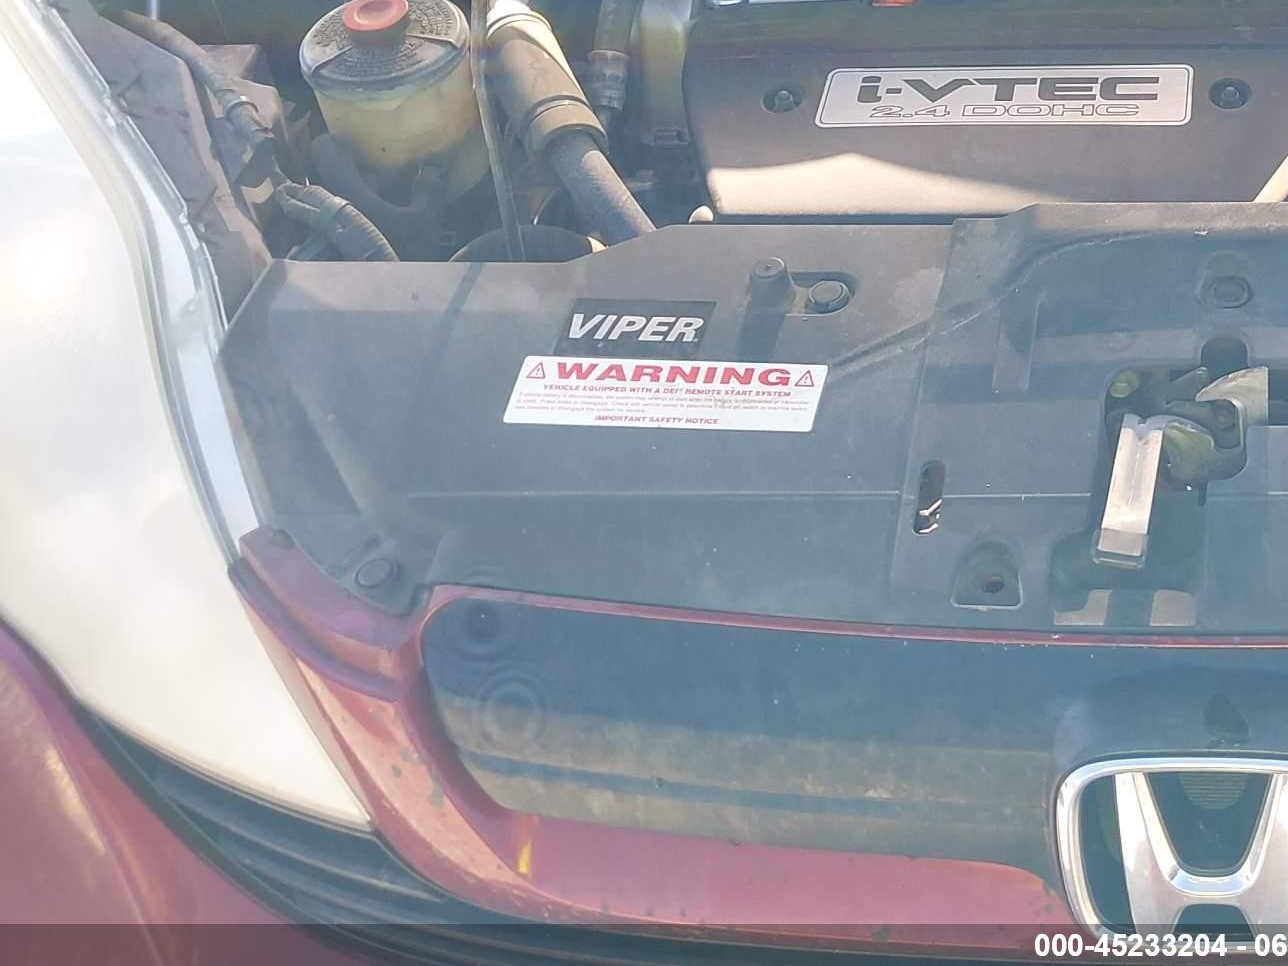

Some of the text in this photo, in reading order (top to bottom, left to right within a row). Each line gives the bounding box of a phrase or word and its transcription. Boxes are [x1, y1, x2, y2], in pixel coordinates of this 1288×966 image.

[857, 75, 1160, 104] i-VTEC
[870, 104, 1140, 119] 2.4 DOHC
[569, 313, 704, 343] VIPER
[556, 362, 792, 387] WARNING
[543, 384, 580, 392] VEHICLE
[582, 384, 627, 393] EQUIPPED
[629, 386, 652, 394] WITH
[685, 388, 722, 396] REMOTE
[723, 389, 753, 397] START
[755, 389, 792, 397] SYSTEM
[594, 415, 720, 425] IMPORTANT SAFETY NOTICE
